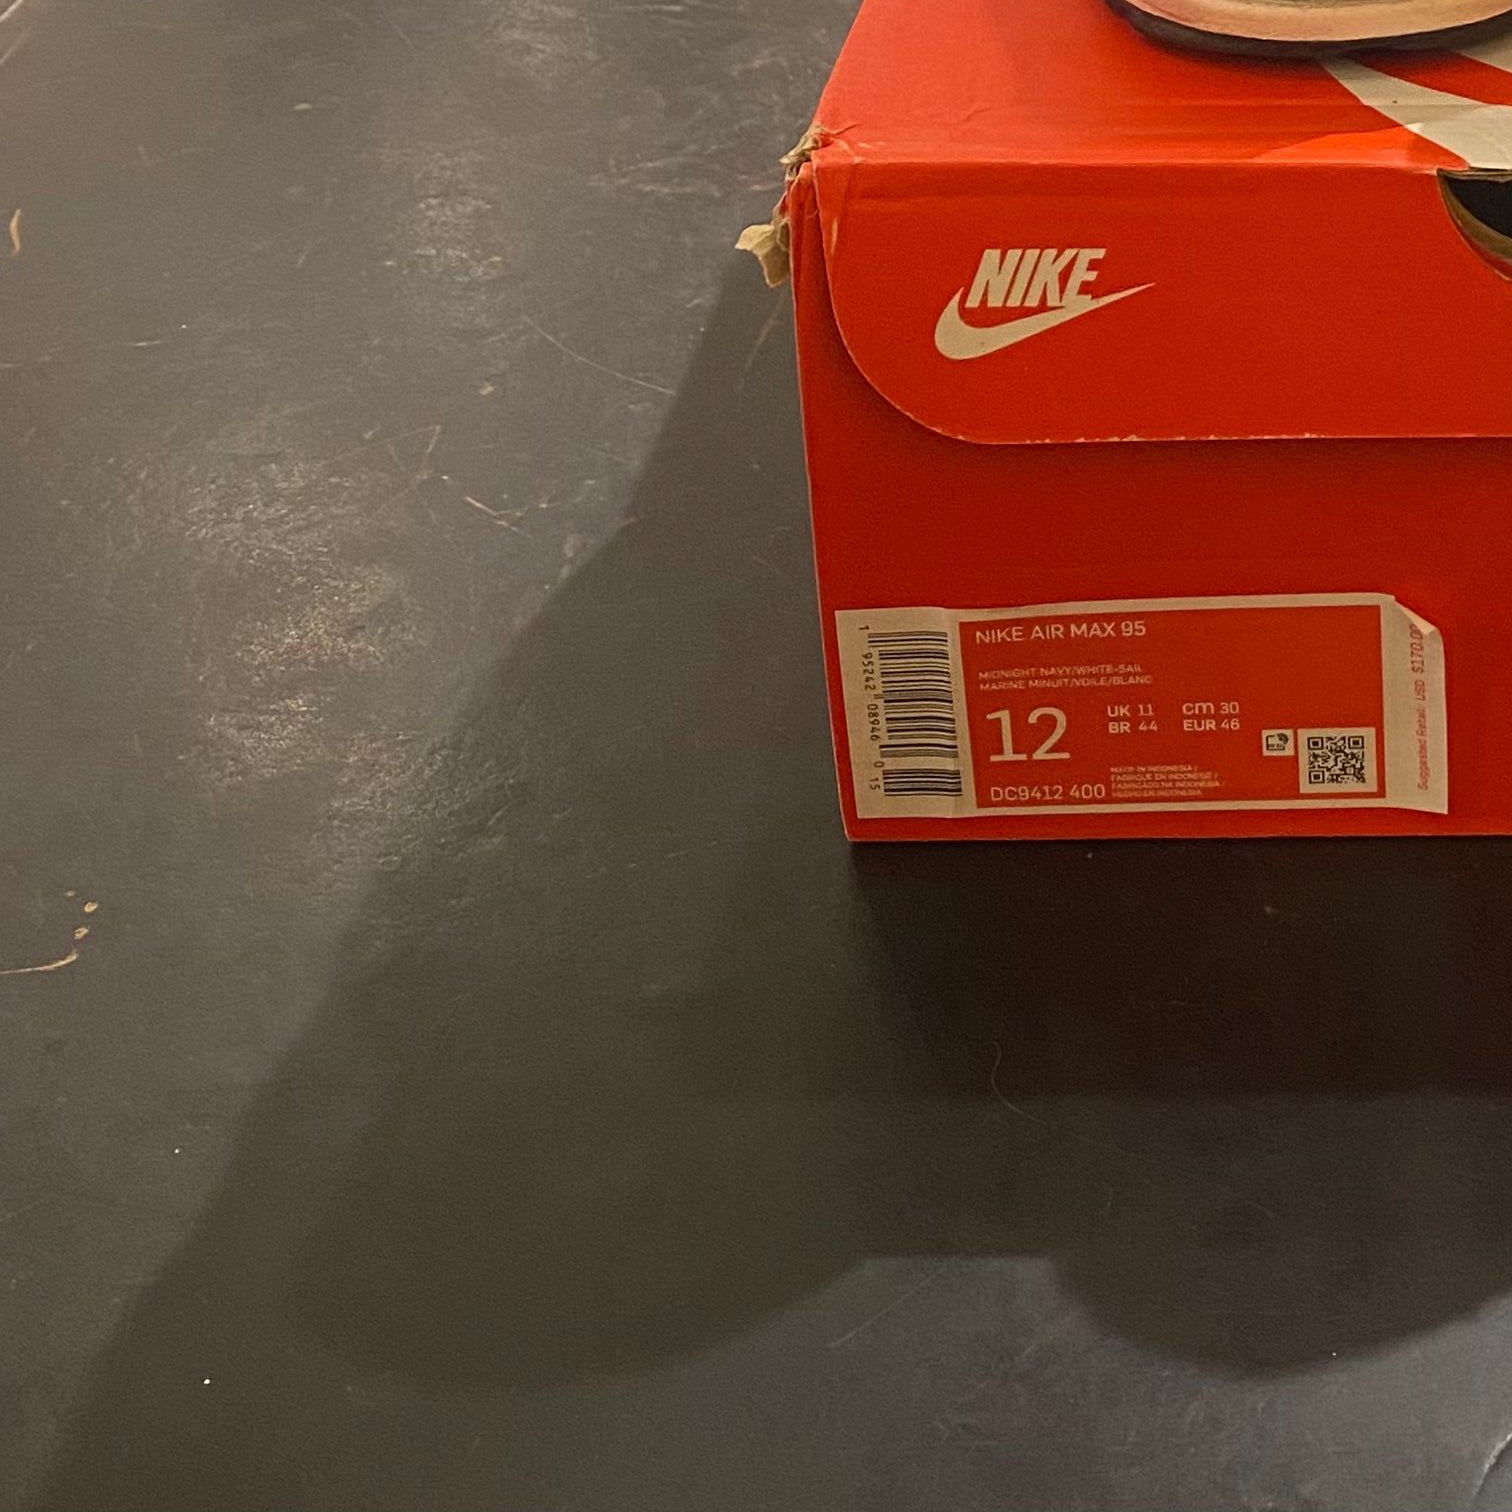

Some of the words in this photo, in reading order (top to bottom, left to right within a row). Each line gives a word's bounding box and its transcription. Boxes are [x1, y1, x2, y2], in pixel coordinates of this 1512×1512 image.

[964, 248, 1108, 309] NIKE
[975, 626, 1025, 645] NIKE
[1030, 623, 1065, 640] AIR
[1069, 621, 1117, 638] MAX
[1120, 619, 1147, 637] 95
[861, 652, 876, 692] 95242
[978, 667, 1036, 681] MIDNIGHT
[979, 679, 1027, 691] MARINE
[1414, 680, 1426, 702] USD
[1107, 704, 1131, 718] UK
[1137, 703, 1155, 717] 11
[1219, 701, 1240, 715] 30
[866, 703, 881, 742] 08946
[1108, 721, 1132, 734] BR
[1137, 720, 1159, 732] 44
[1183, 719, 1217, 732] EUR
[1219, 718, 1241, 731] 46
[985, 706, 1071, 763] 12
[873, 761, 885, 769] 0
[990, 784, 1064, 802] DC9412
[1069, 783, 1106, 800] 400
